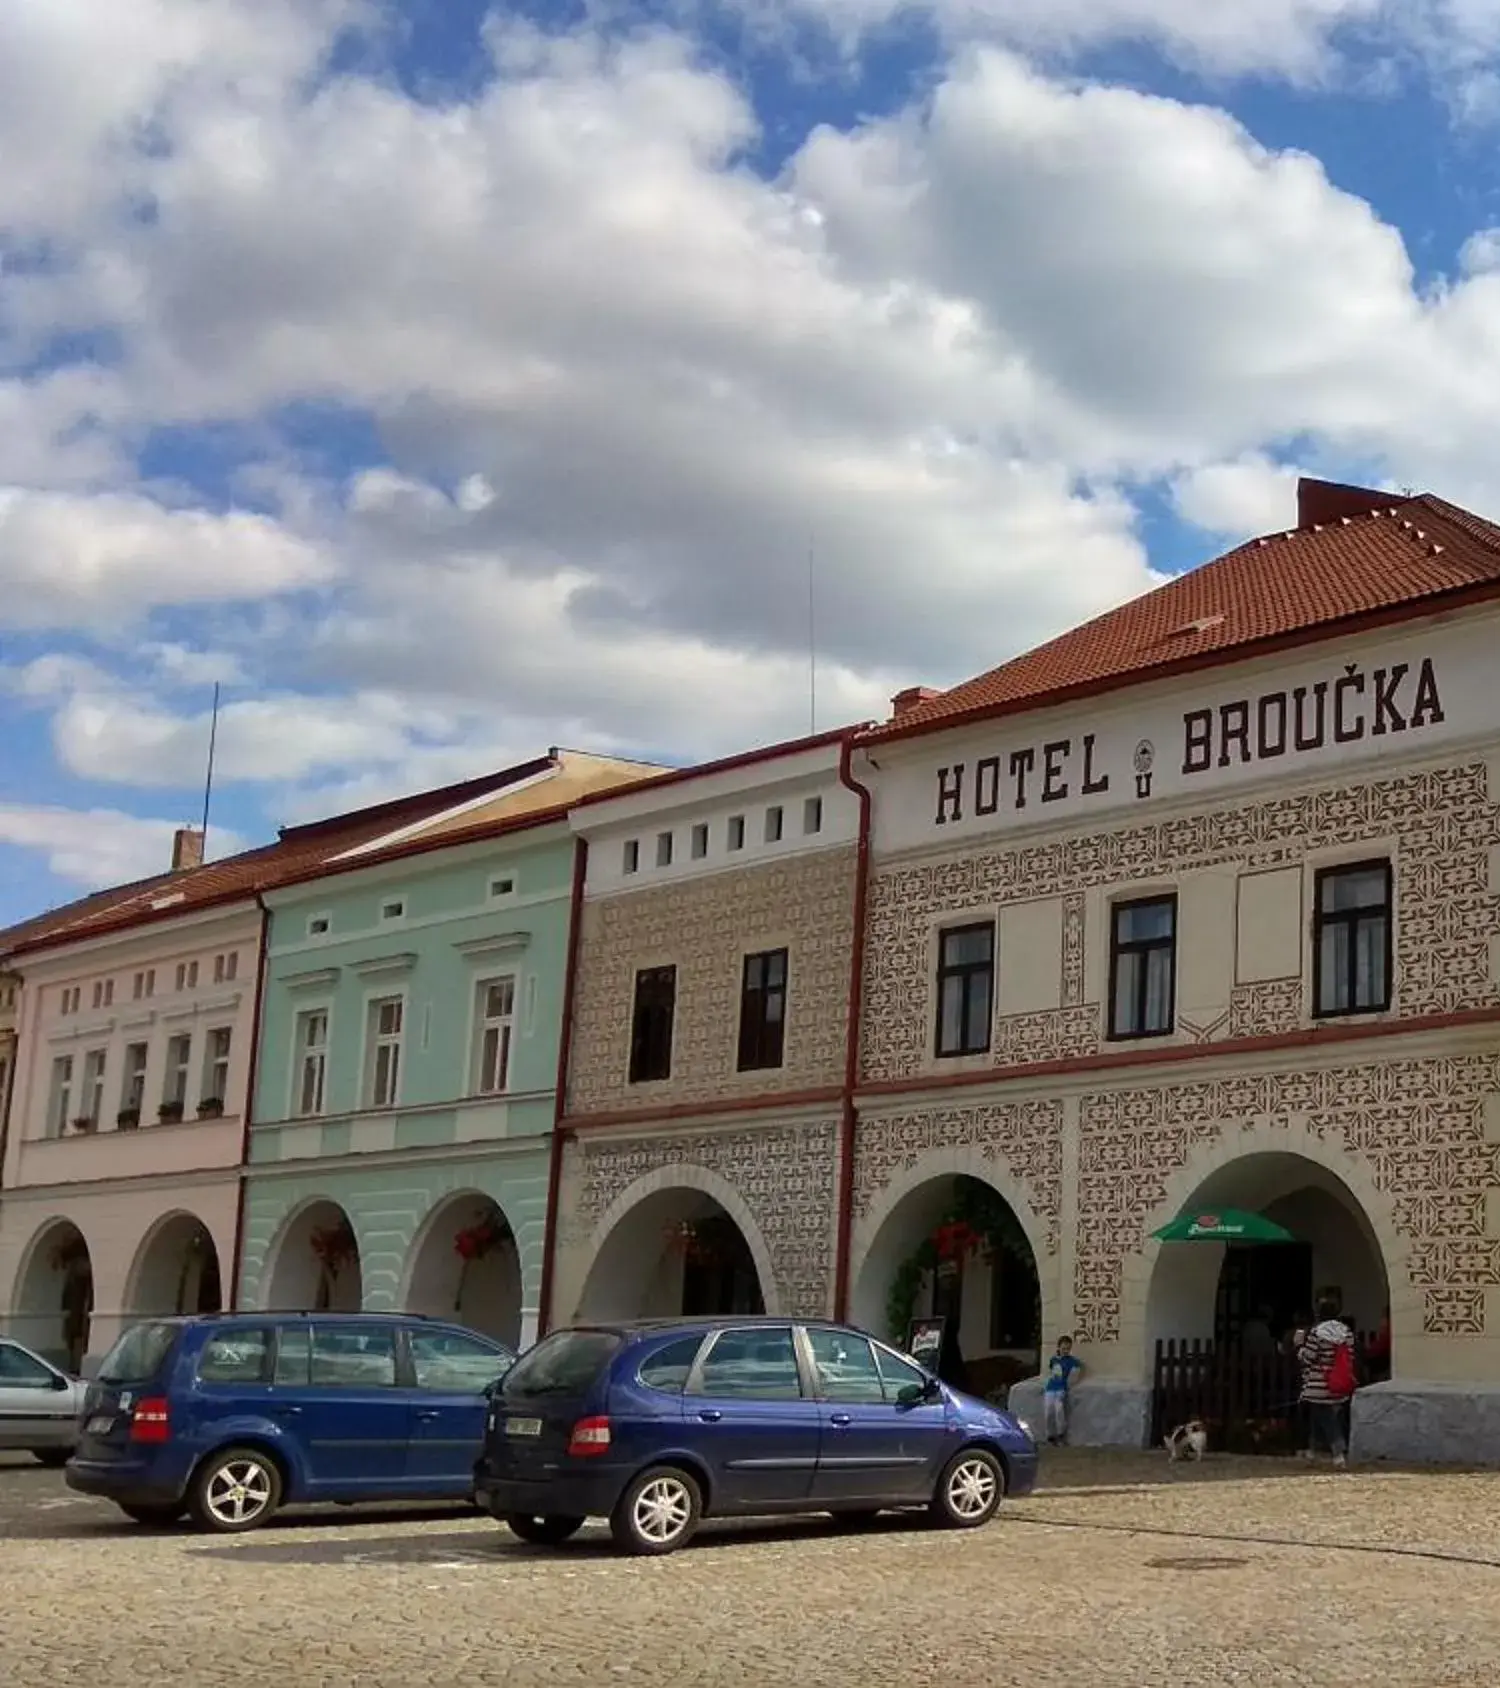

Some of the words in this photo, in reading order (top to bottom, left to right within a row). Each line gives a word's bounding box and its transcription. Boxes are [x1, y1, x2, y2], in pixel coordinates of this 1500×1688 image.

[935, 733, 1109, 825] HOTEL
[1135, 771, 1154, 799] U
[1181, 657, 1446, 775] BROUČKA
